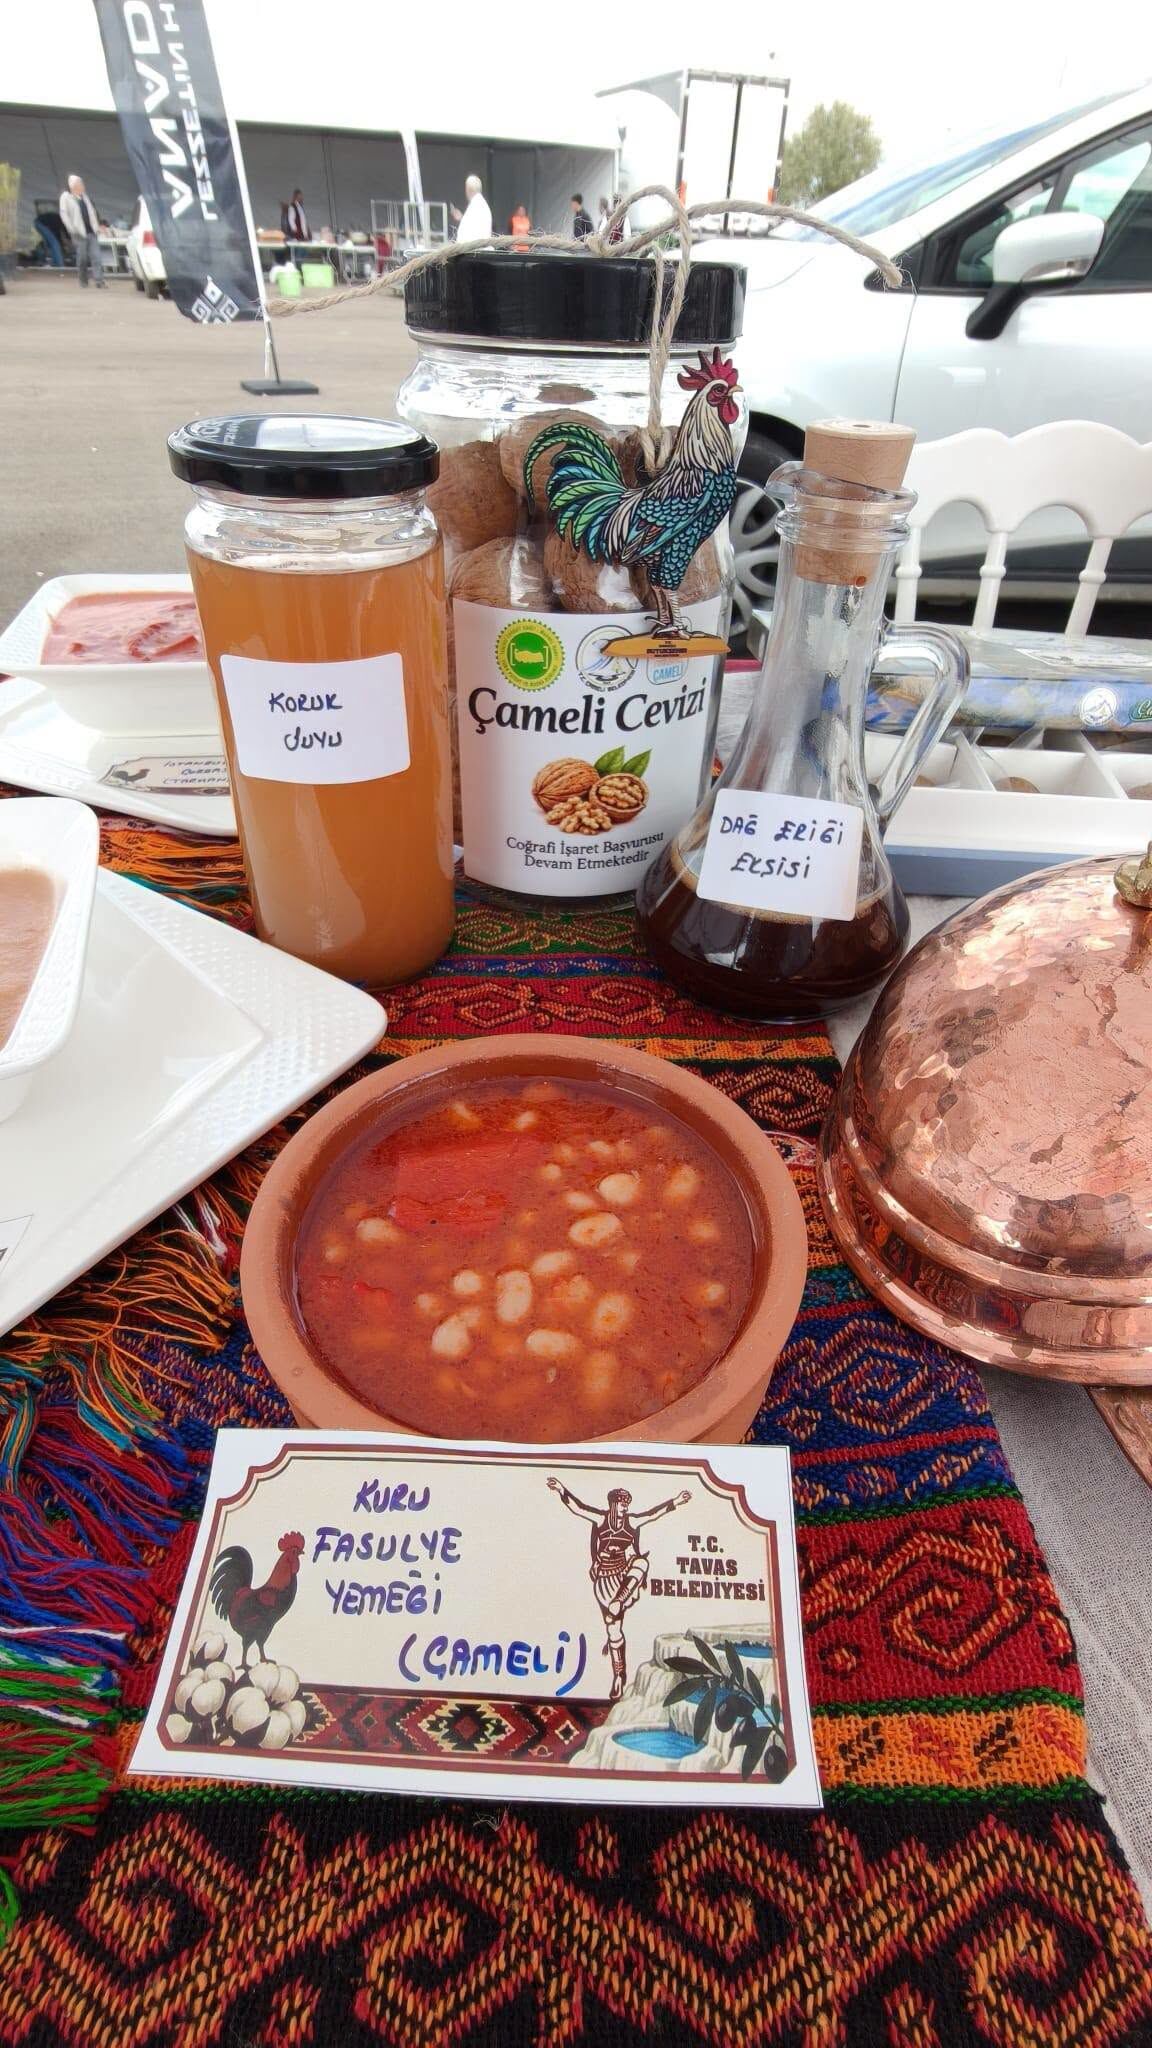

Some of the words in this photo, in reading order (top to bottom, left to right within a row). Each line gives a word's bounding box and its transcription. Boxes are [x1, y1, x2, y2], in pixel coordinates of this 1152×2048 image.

[268, 692, 343, 713] KORUK
[468, 687, 605, 735] Çameli
[615, 677, 708, 733] Cevizi
[720, 814, 758, 836] DAĞ
[774, 819, 844, 845] ERİĞİ
[506, 836, 556, 854] Coğrafi
[560, 840, 599, 857] İşaret
[602, 832, 664, 854] Başvurusu
[524, 854, 573, 870] Devam
[577, 850, 650, 870] Etmektedir
[353, 1478, 431, 1513] KURU
[312, 1526, 463, 1563] FASULYE
[687, 1534, 724, 1553] T.C.
[676, 1556, 738, 1576] TAVAS
[325, 1569, 442, 1615] YEMEĞİ
[650, 1577, 766, 1601] BELEDİYESİ
